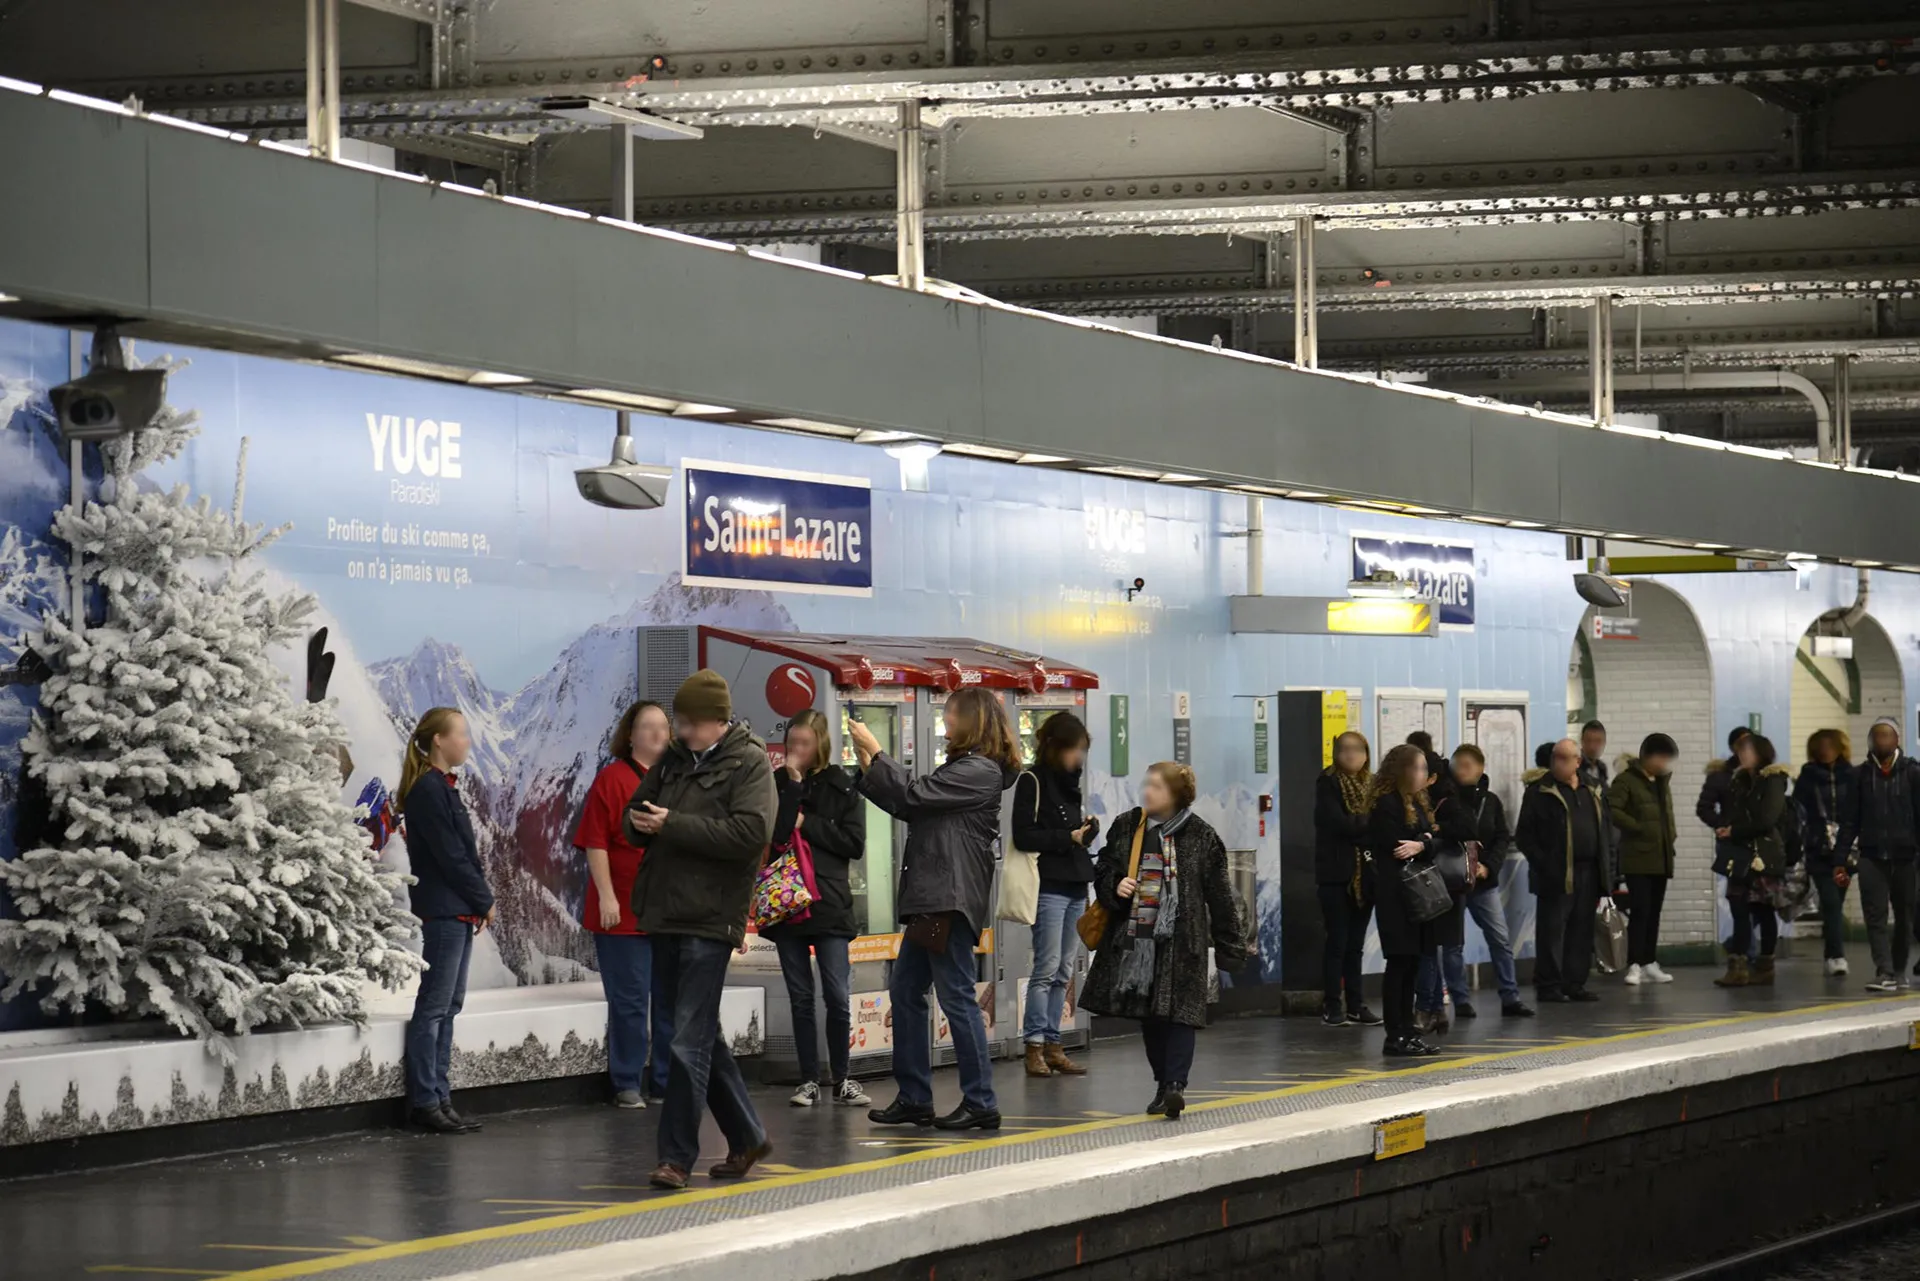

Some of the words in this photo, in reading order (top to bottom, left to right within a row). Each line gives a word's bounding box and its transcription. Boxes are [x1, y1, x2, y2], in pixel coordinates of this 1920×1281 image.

[365, 412, 462, 479] YUGE
[390, 479, 440, 506] Paradiski
[327, 516, 378, 543] Profiter
[381, 522, 398, 544] du
[401, 524, 419, 546] ski
[423, 529, 468, 550] comme
[472, 532, 491, 556] ça,
[704, 495, 861, 563] Saint-Lazare
[348, 560, 364, 580] on
[367, 557, 387, 580] n'a
[390, 558, 432, 585] jamais
[435, 565, 450, 583] vu
[453, 567, 472, 590] ça.
[749, 944, 776, 952] selecta
